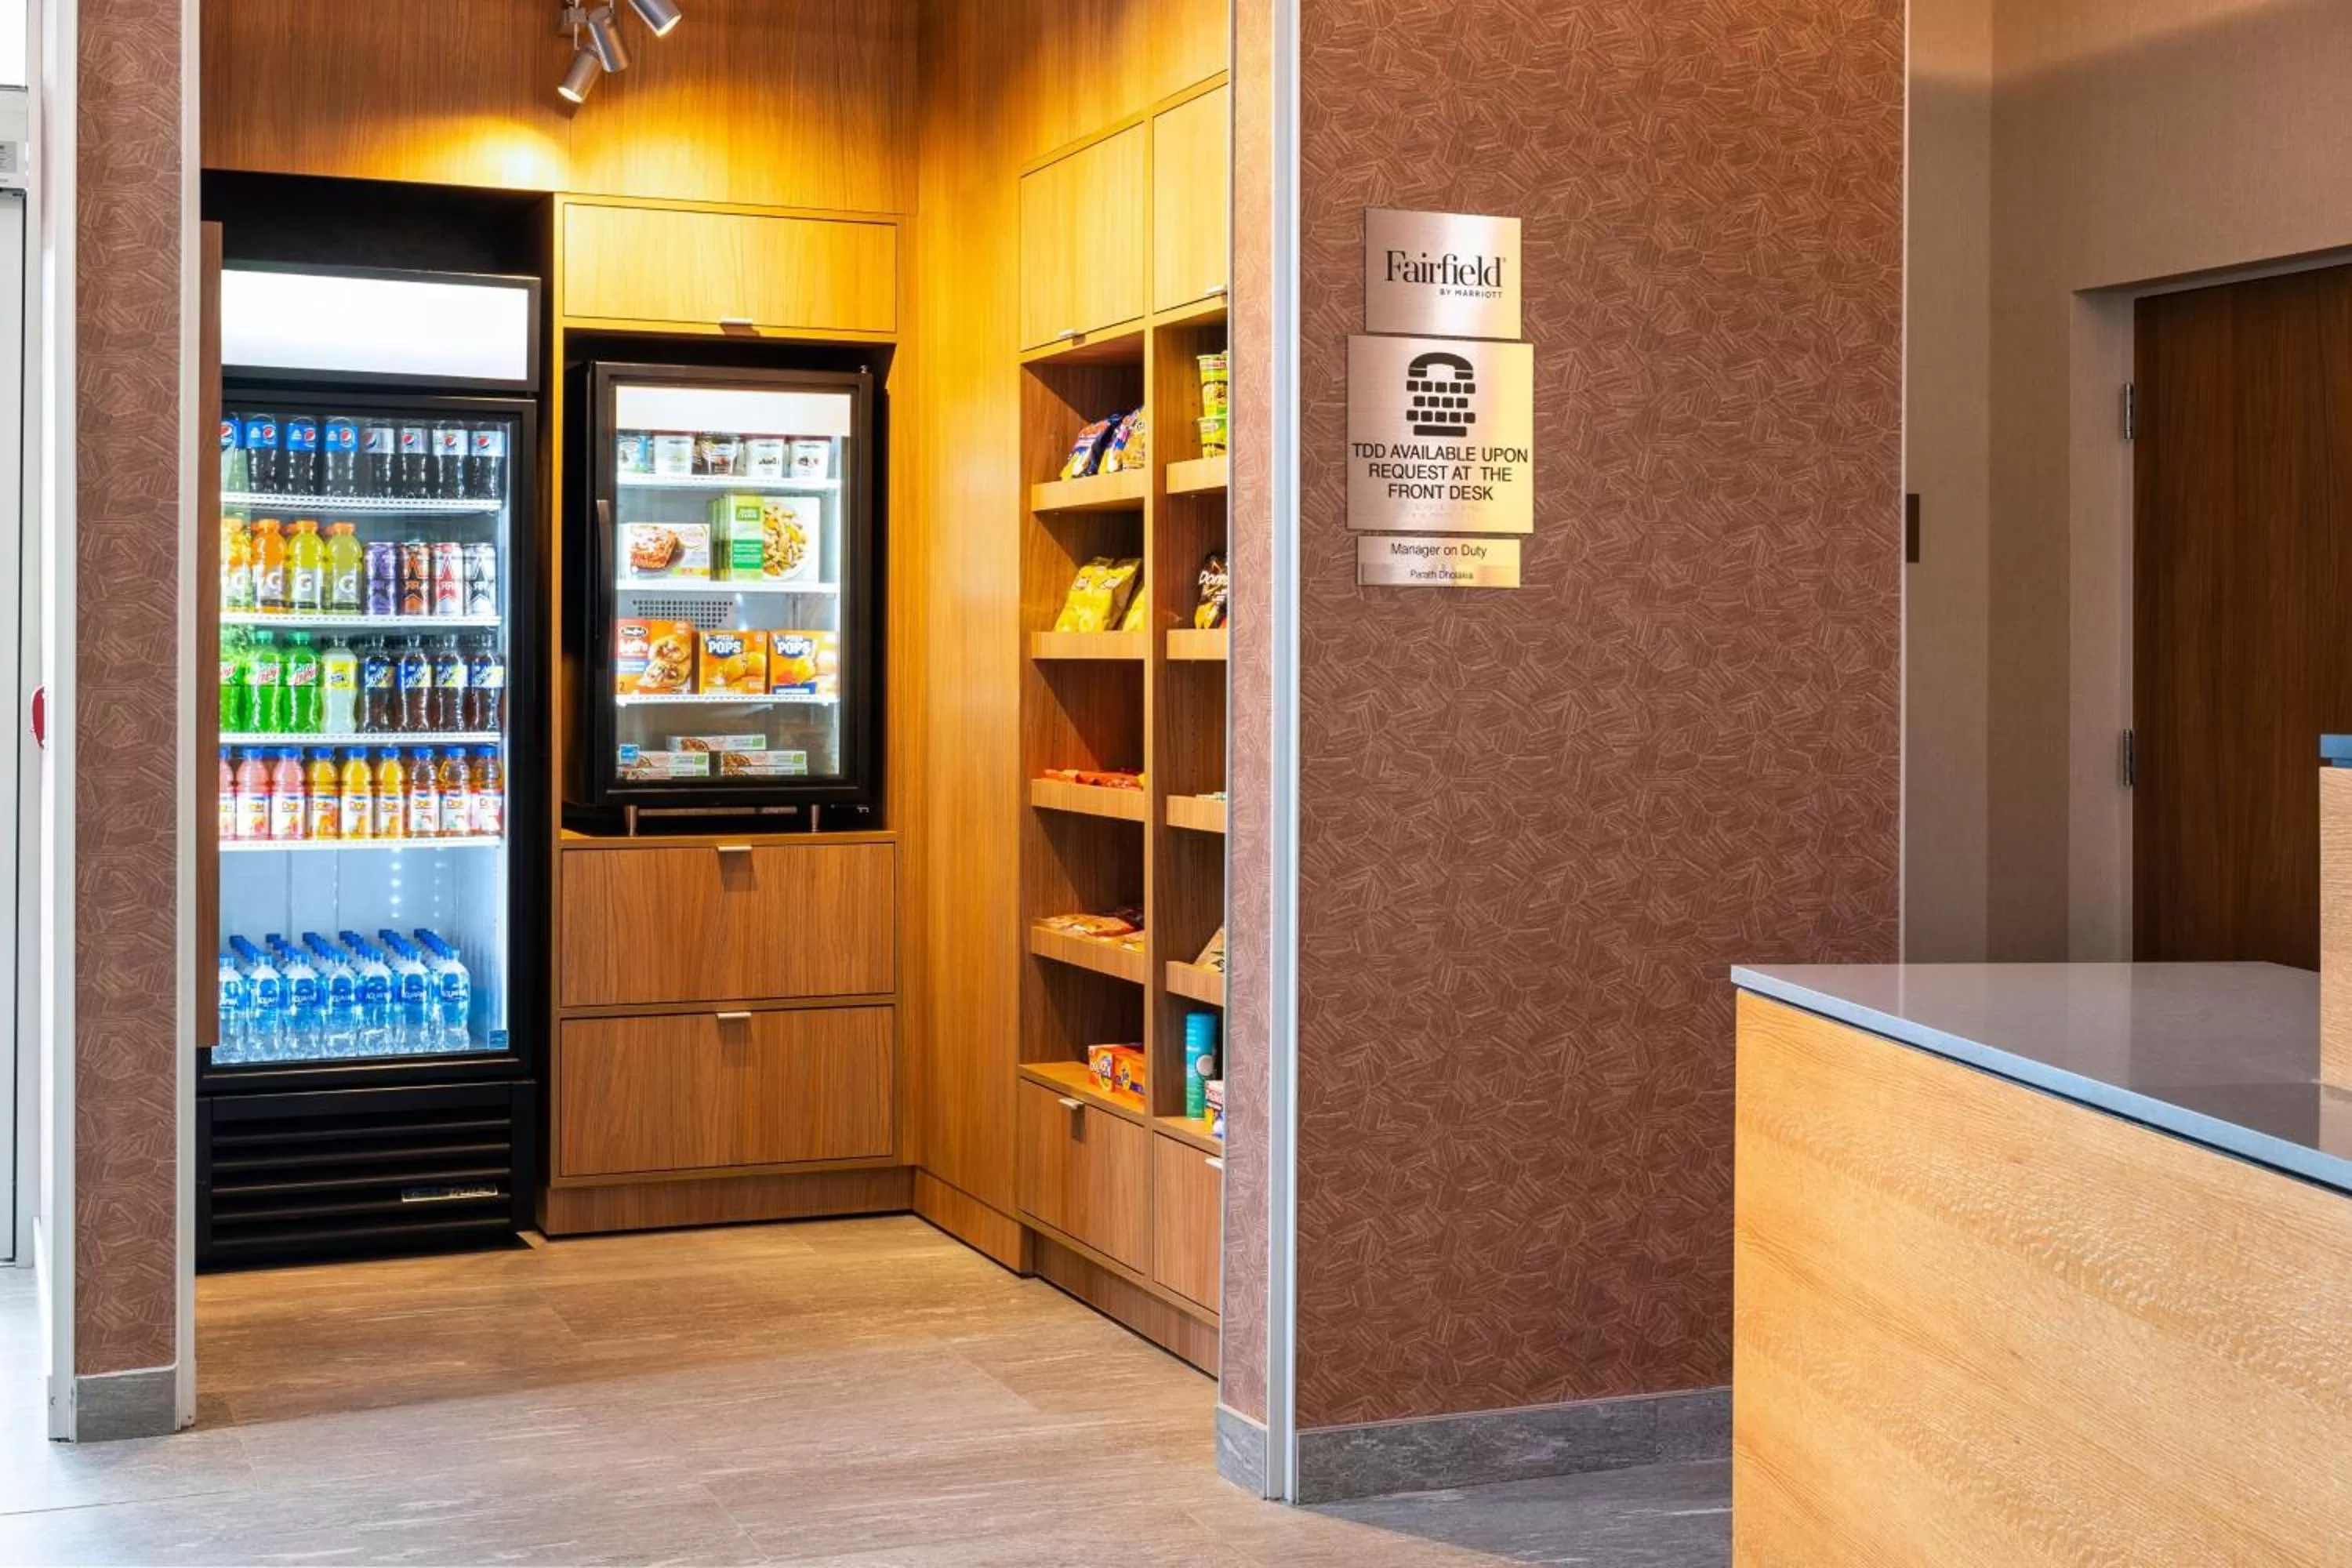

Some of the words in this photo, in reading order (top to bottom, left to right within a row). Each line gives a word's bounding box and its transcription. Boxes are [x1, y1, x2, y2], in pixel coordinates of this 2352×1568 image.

[1385, 250, 1502, 288] Fairfield
[1455, 289, 1503, 299] MARRIOTT
[1352, 442, 1386, 459] TDD
[1390, 444, 1476, 462] AVAILABLE
[1482, 448, 1528, 463] UPON
[1369, 464, 1448, 481] REQUEST
[1452, 466, 1472, 481] AT
[1480, 466, 1512, 482] THE
[1388, 484, 1445, 499] FRONT
[1450, 485, 1494, 500] DESK
[1390, 543, 1439, 557] Manager
[1461, 544, 1487, 559] Duty
[707, 640, 742, 654] POPS
[776, 640, 811, 655] POPS
